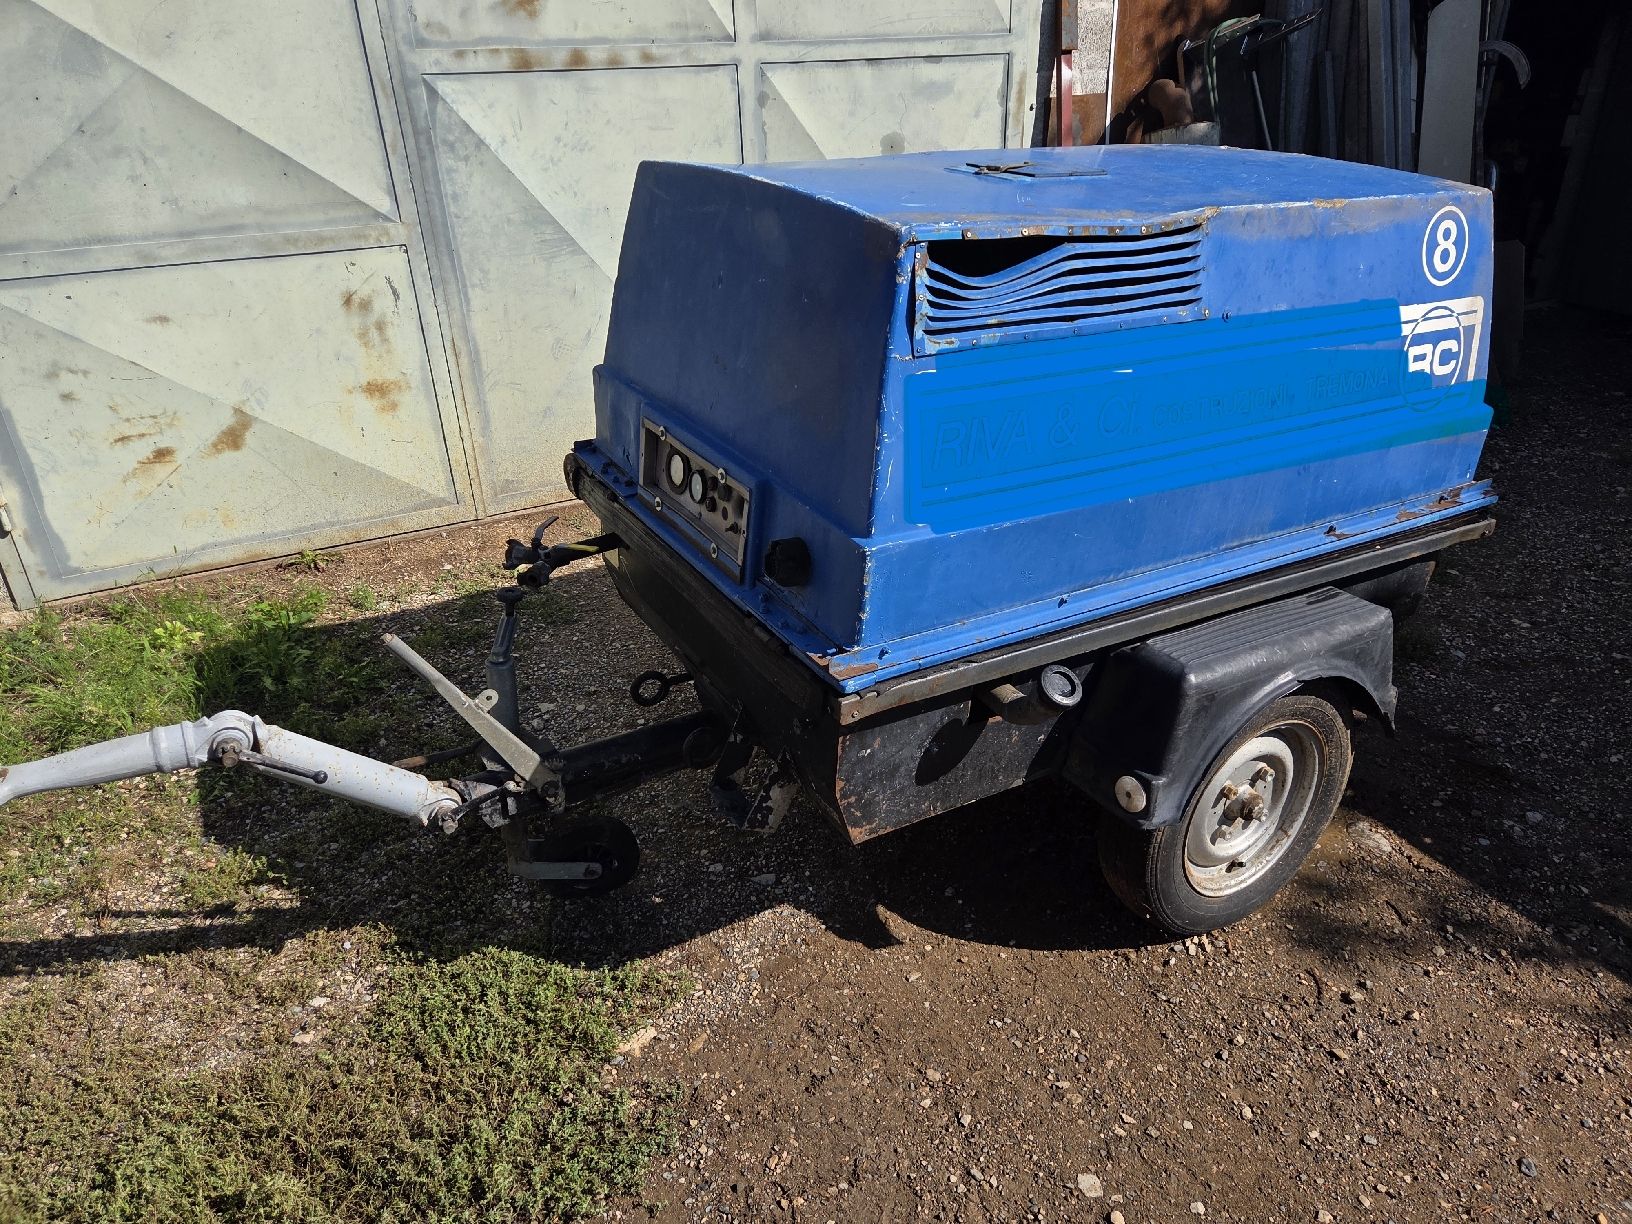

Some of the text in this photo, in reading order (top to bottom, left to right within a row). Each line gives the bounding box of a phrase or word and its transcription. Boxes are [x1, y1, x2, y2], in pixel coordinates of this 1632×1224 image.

[1433, 219, 1457, 273] 8
[930, 408, 1034, 471] RIVA
[1049, 401, 1080, 449] &
[1304, 367, 1389, 400] TREMONA
